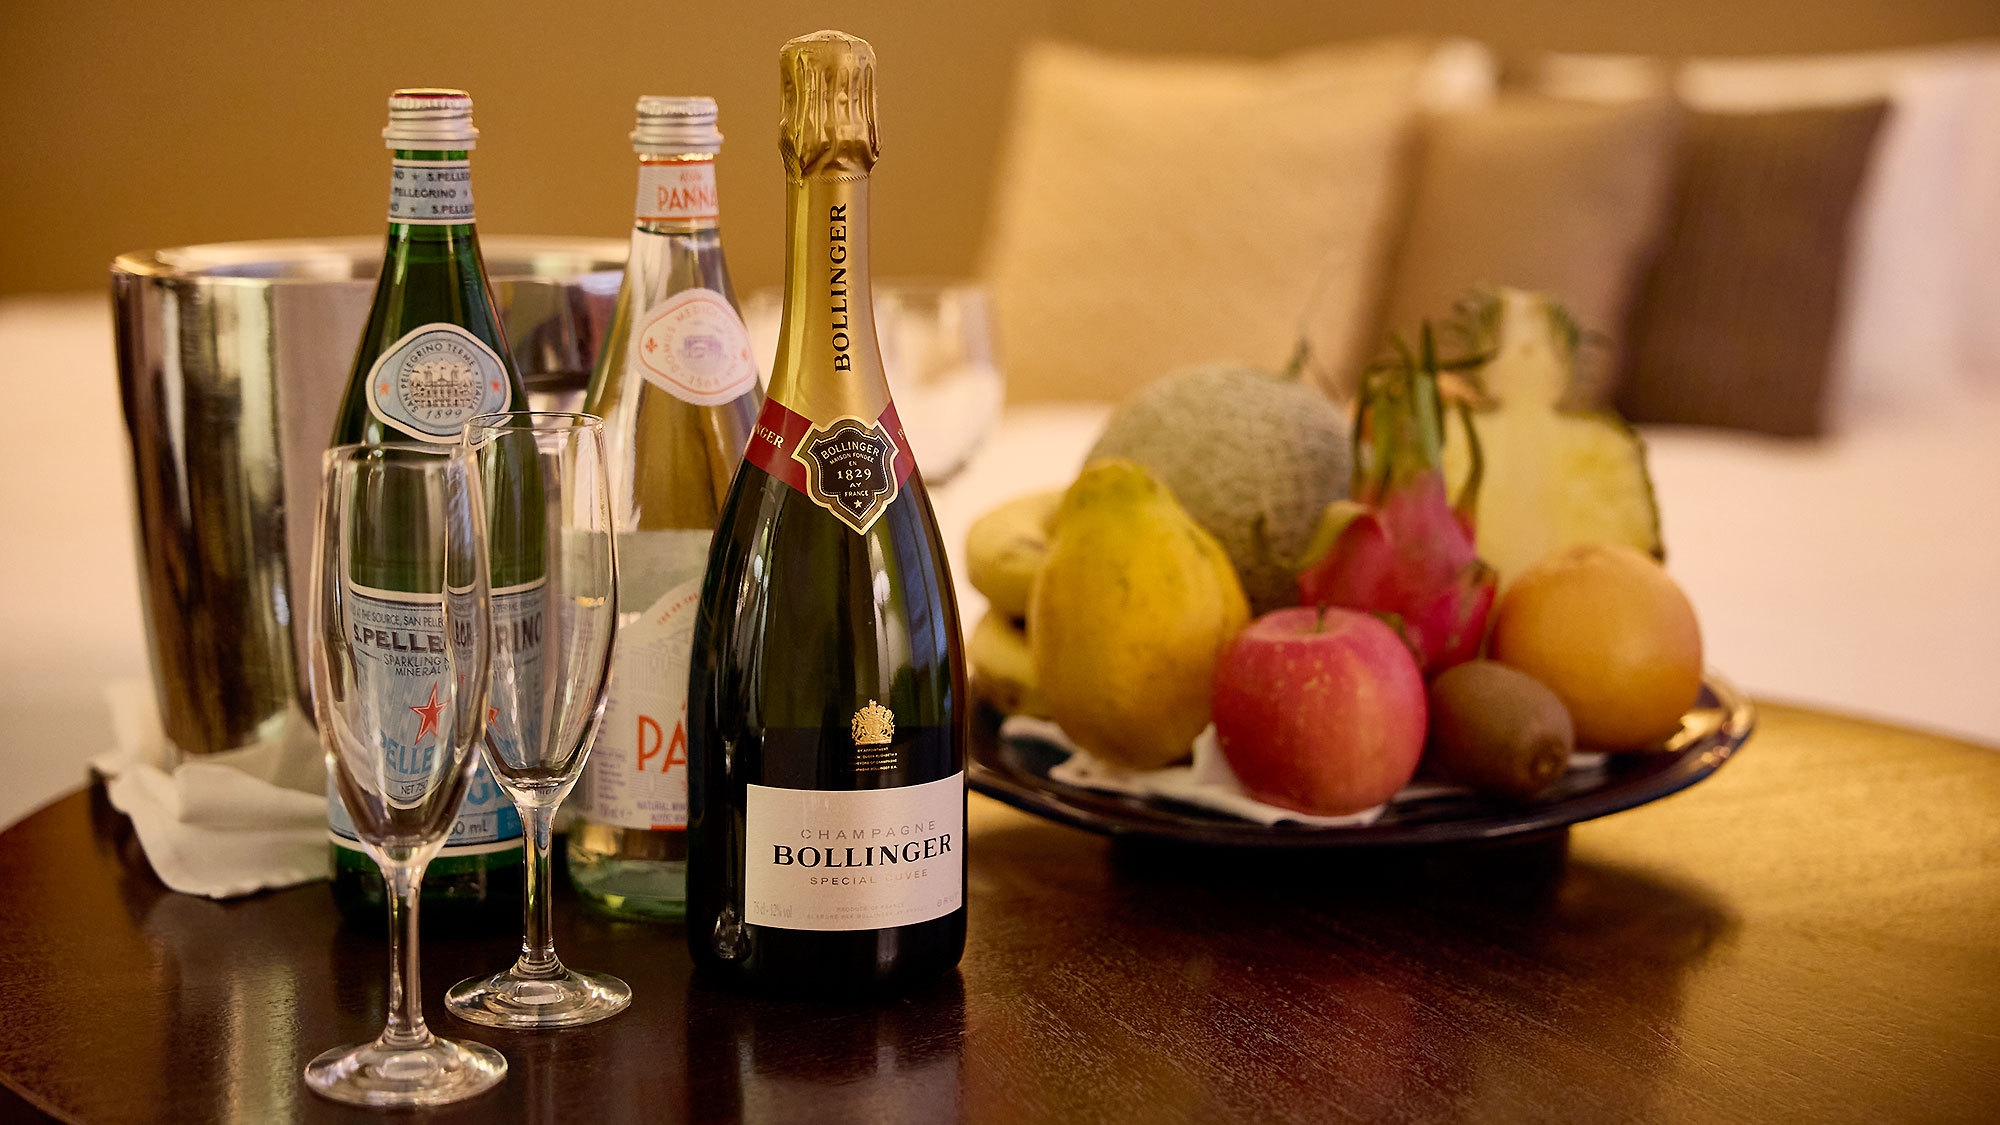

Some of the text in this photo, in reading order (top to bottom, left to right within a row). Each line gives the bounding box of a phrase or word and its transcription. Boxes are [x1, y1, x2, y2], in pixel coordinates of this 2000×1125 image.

[656, 184, 717, 212] PANNA
[829, 203, 852, 372] BOLLINGER
[400, 342, 482, 413] SAN PELLEGRINO TERME ITALIA
[426, 408, 463, 420] 1899
[820, 440, 880, 460] BOLLINGER
[829, 453, 852, 465] MAISON
[836, 468, 872, 481] 1829
[844, 489, 869, 498] FRANCE
[403, 615, 421, 627] SAN
[383, 653, 442, 668] SPARKLING
[395, 667, 441, 677] MINERAL
[401, 782, 414, 795] NET
[801, 820, 936, 840] CHAMPAGNE
[773, 833, 952, 868] BOLLINGER
[810, 875, 876, 886] SPECIAL
